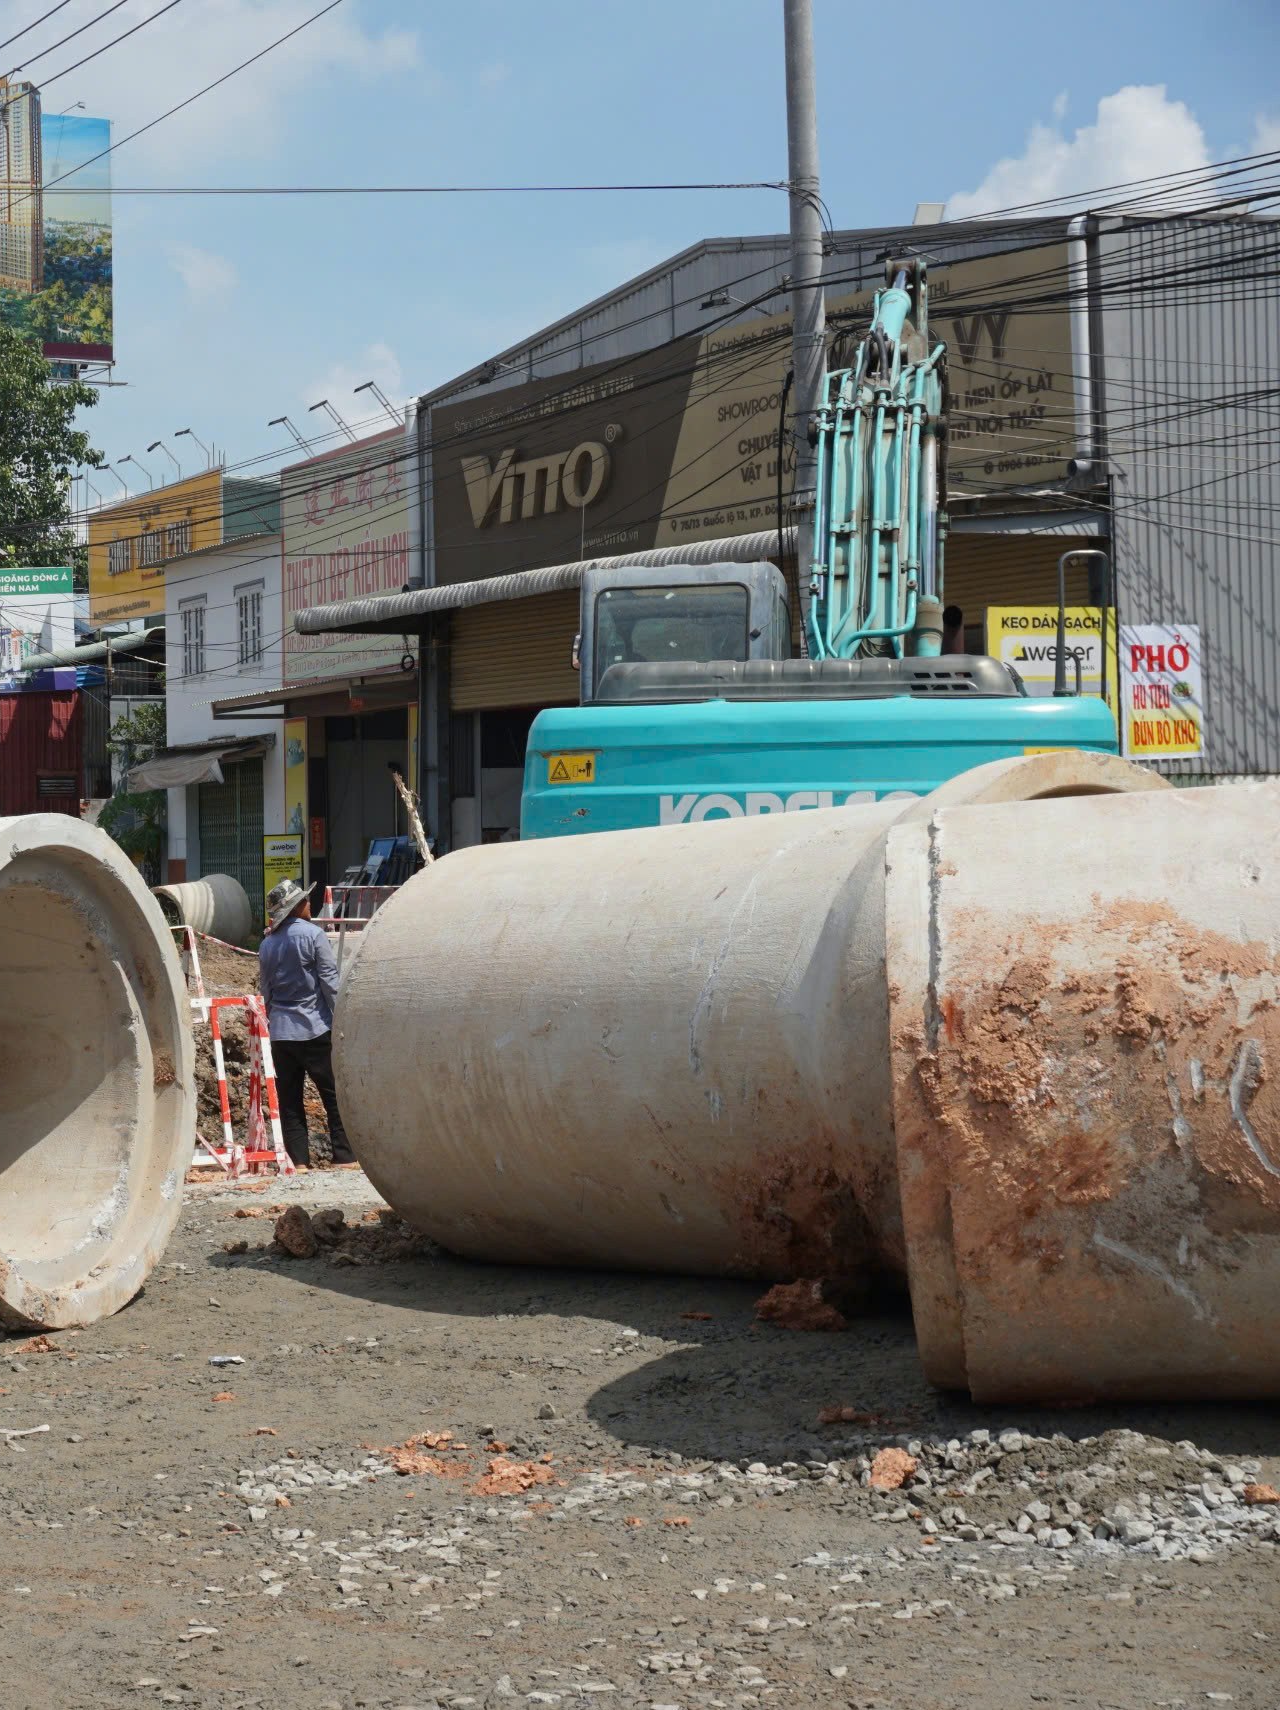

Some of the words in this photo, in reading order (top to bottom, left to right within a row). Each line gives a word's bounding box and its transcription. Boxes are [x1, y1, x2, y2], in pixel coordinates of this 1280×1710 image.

[953, 313, 1007, 364] VY
[965, 385, 996, 409] MEN
[738, 428, 784, 455] CHUYÊ
[740, 461, 762, 485] VẬT
[766, 460, 791, 478] LIU
[18, 583, 40, 592] NAM
[1001, 616, 1029, 629] KEO
[1130, 634, 1190, 673] PHỞ
[1133, 716, 1155, 747] BÚN
[1174, 720, 1196, 745] KHO
